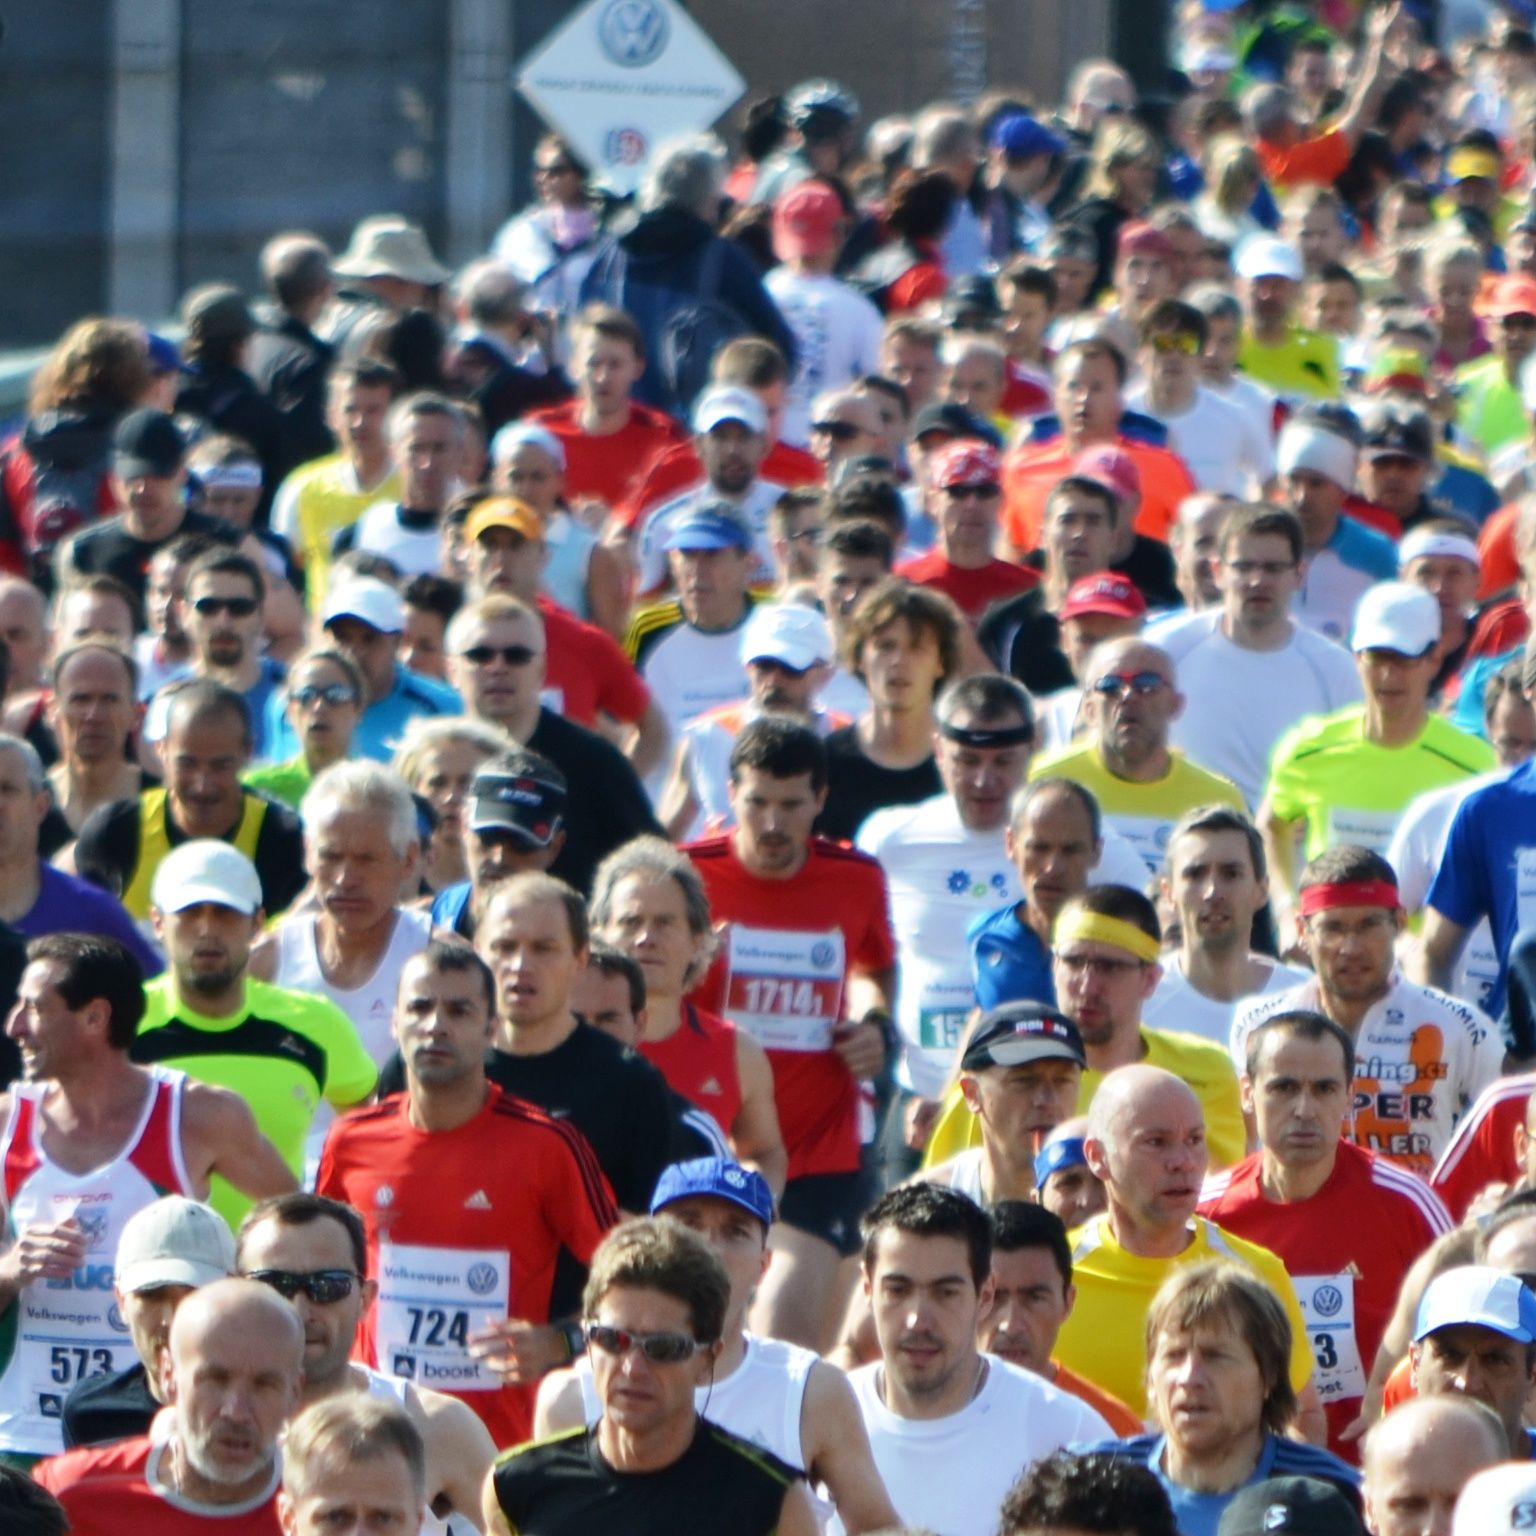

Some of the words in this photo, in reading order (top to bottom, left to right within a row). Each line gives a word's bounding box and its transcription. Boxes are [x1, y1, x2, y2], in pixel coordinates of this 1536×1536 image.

[383, 1265, 460, 1285] Volkswagen
[25, 1304, 102, 1324] Volkswagen
[406, 1308, 469, 1346] 724
[50, 1346, 111, 1384] 573
[422, 1360, 481, 1379] boost
